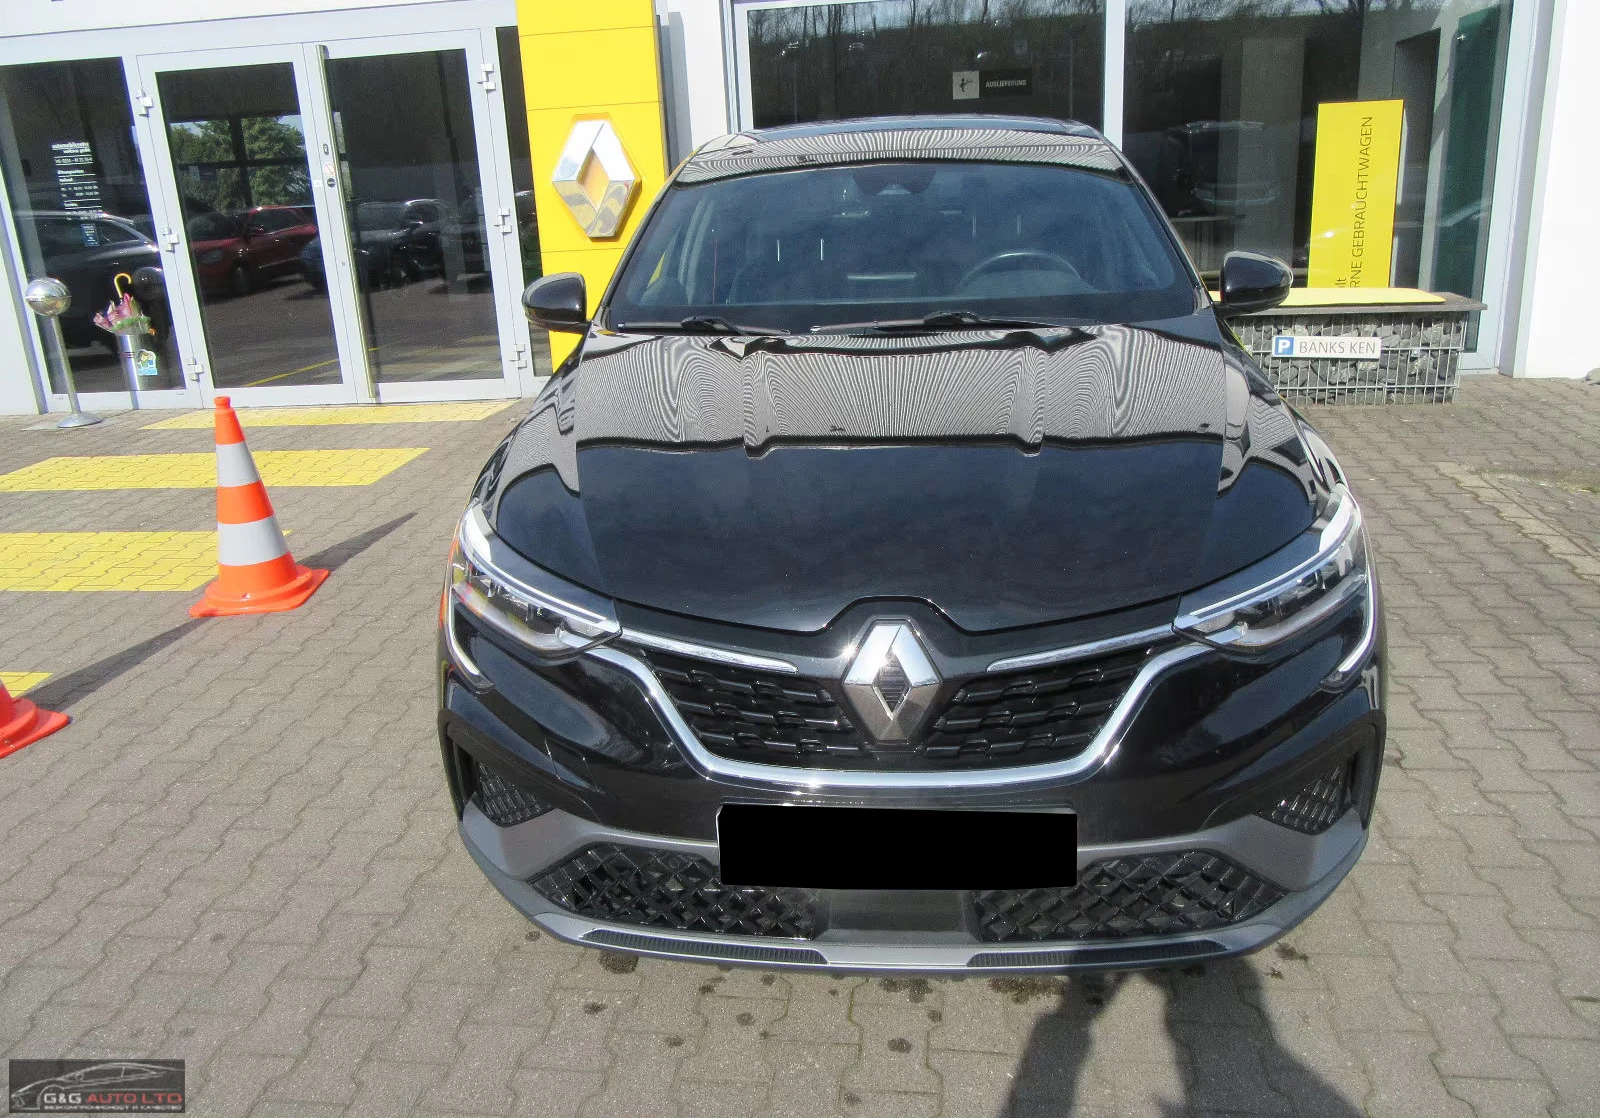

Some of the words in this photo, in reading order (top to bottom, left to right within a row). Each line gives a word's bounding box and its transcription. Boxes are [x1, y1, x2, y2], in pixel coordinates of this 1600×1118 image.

[985, 79, 1027, 88] AUSLIEFERUNG
[1351, 116, 1373, 258] GEBRAUCHTWAGEN
[1277, 339, 1291, 354] P
[1349, 341, 1376, 354] KEN
